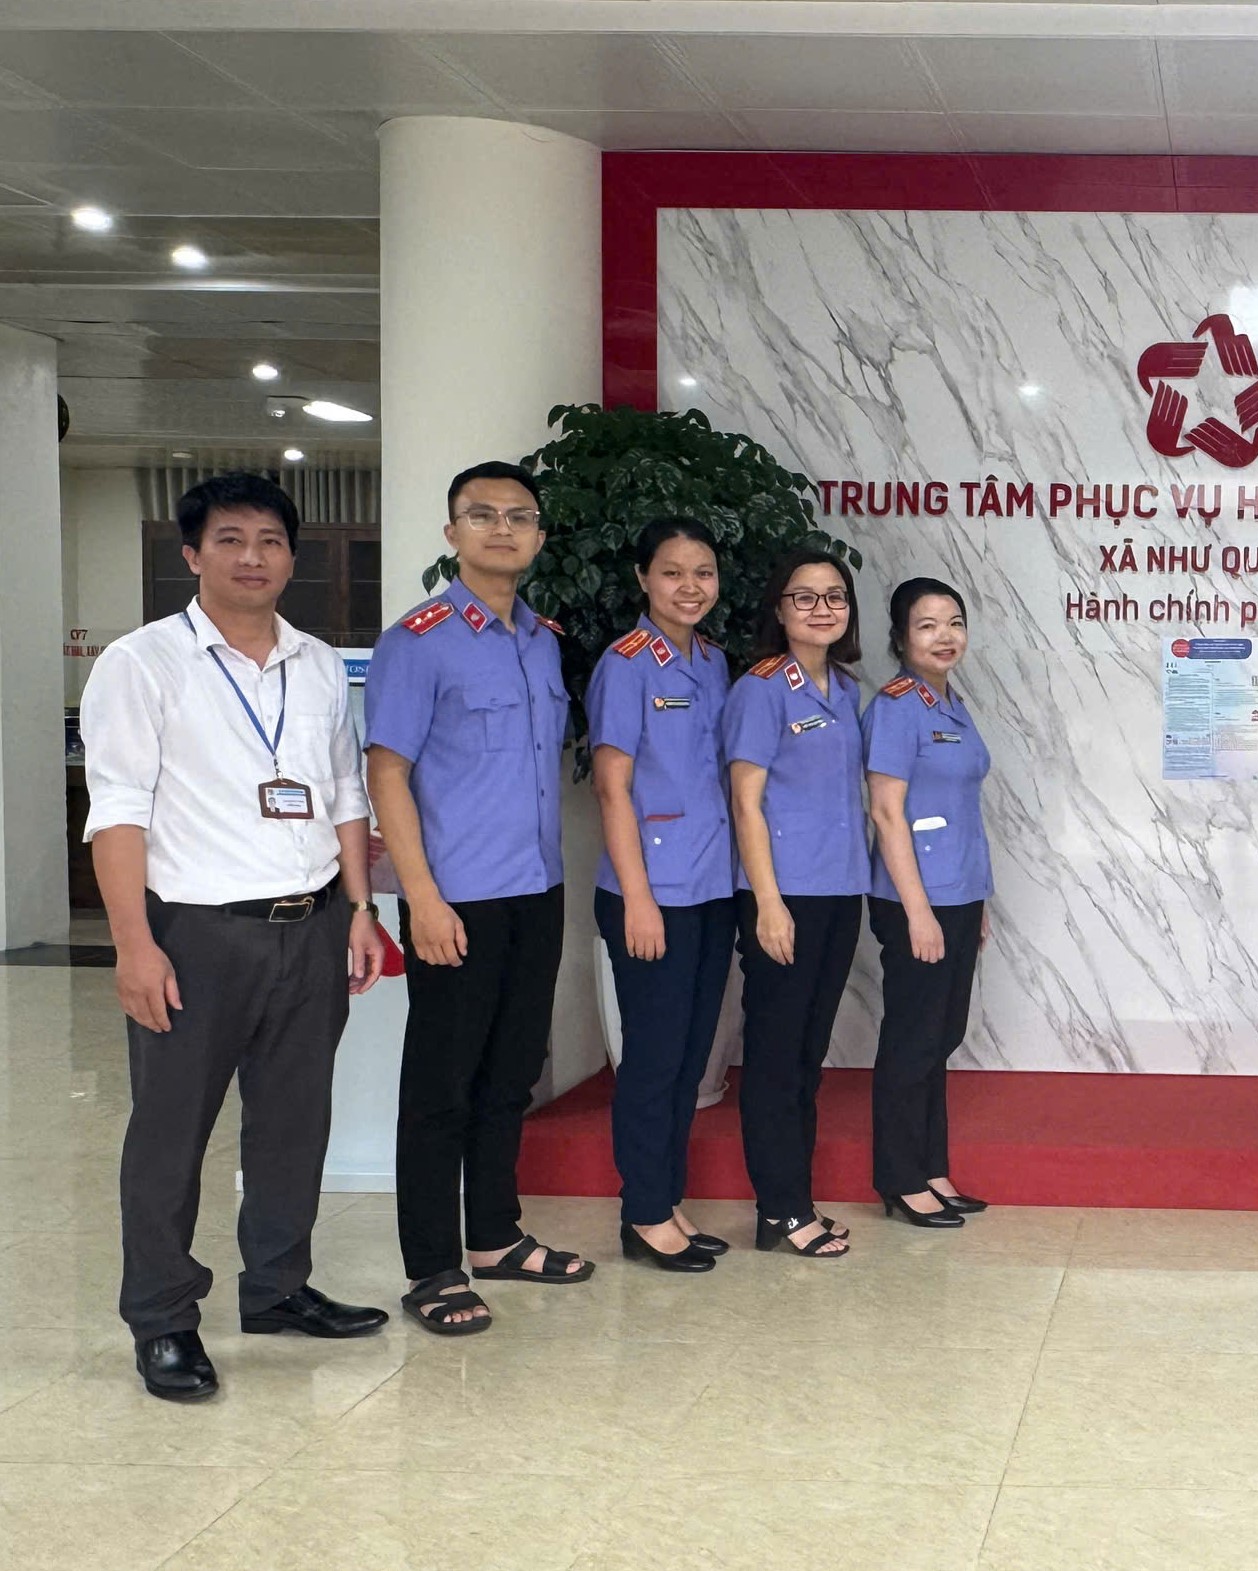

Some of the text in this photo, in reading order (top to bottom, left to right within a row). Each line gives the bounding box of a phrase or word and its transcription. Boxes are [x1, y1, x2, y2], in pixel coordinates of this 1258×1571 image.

[818, 480, 949, 517] TRUNG
[959, 474, 1035, 519] TÂM
[1049, 483, 1159, 528] PHỤC
[1170, 483, 1222, 528] VỤ
[1099, 537, 1139, 574] XÃ
[1146, 543, 1213, 575] NHƯ
[1065, 592, 1140, 623] Hành
[1149, 588, 1231, 624] chính
